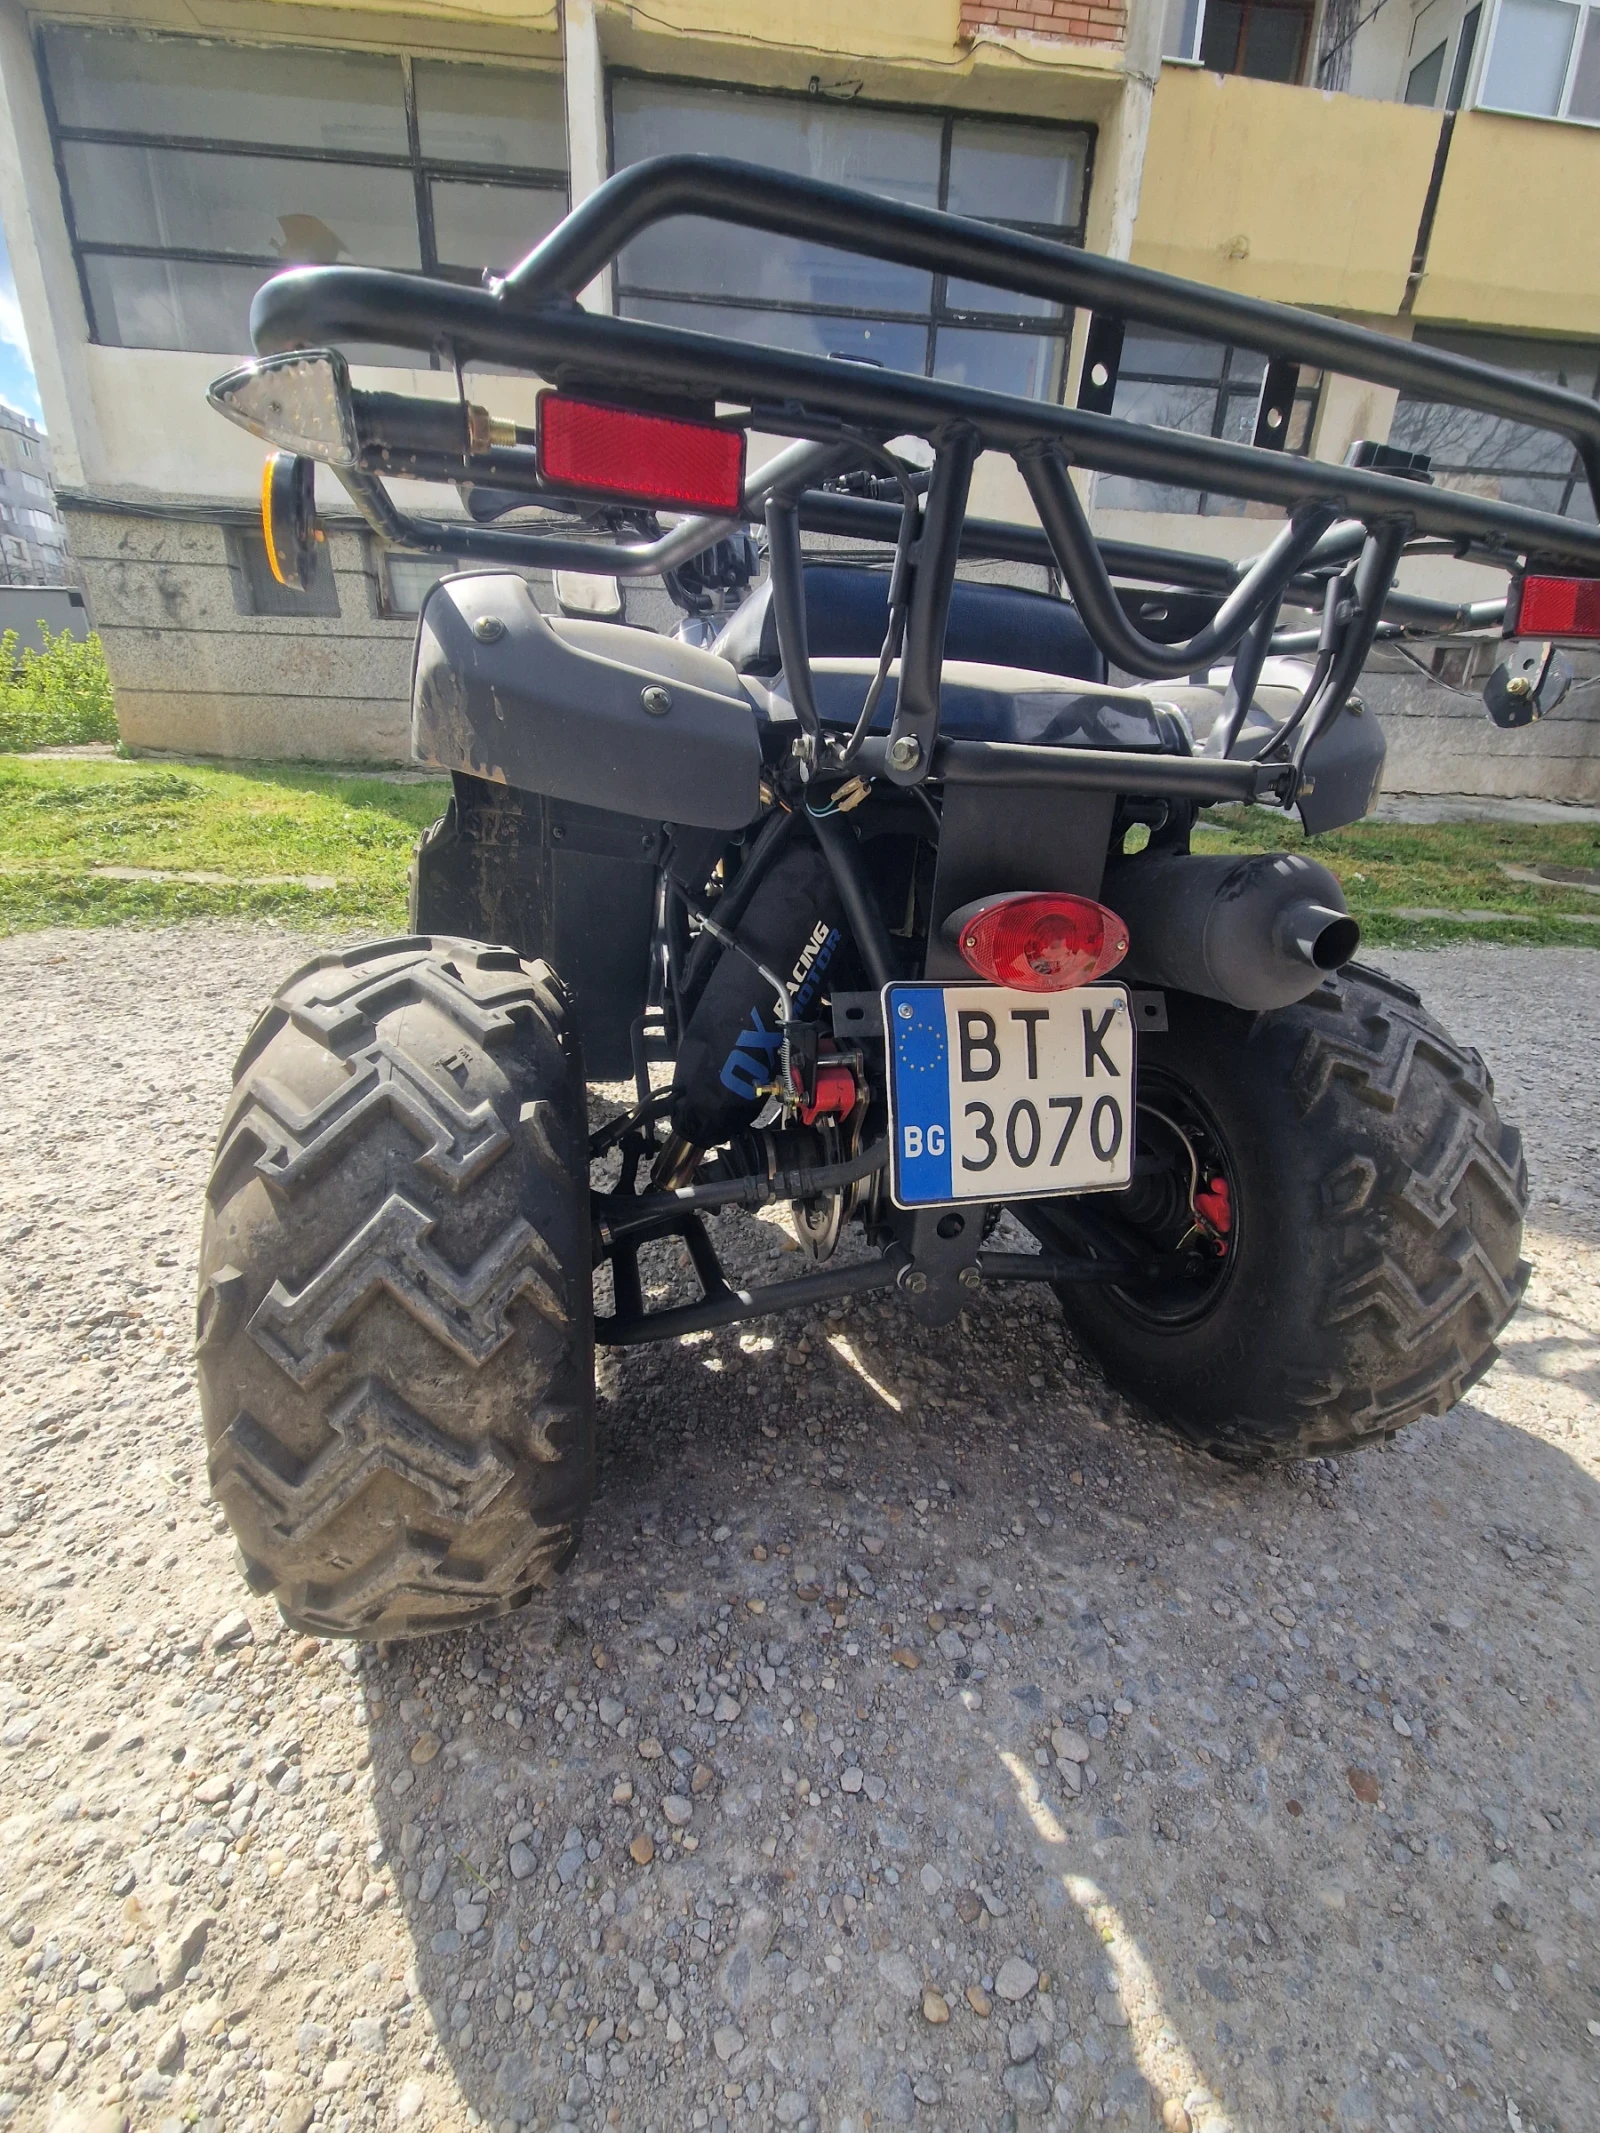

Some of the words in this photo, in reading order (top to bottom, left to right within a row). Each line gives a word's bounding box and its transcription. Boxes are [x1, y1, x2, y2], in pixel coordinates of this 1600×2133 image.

[772, 919, 830, 1020] RACING
[903, 1124, 946, 1159] BG
[961, 1094, 1124, 1172] 3070
